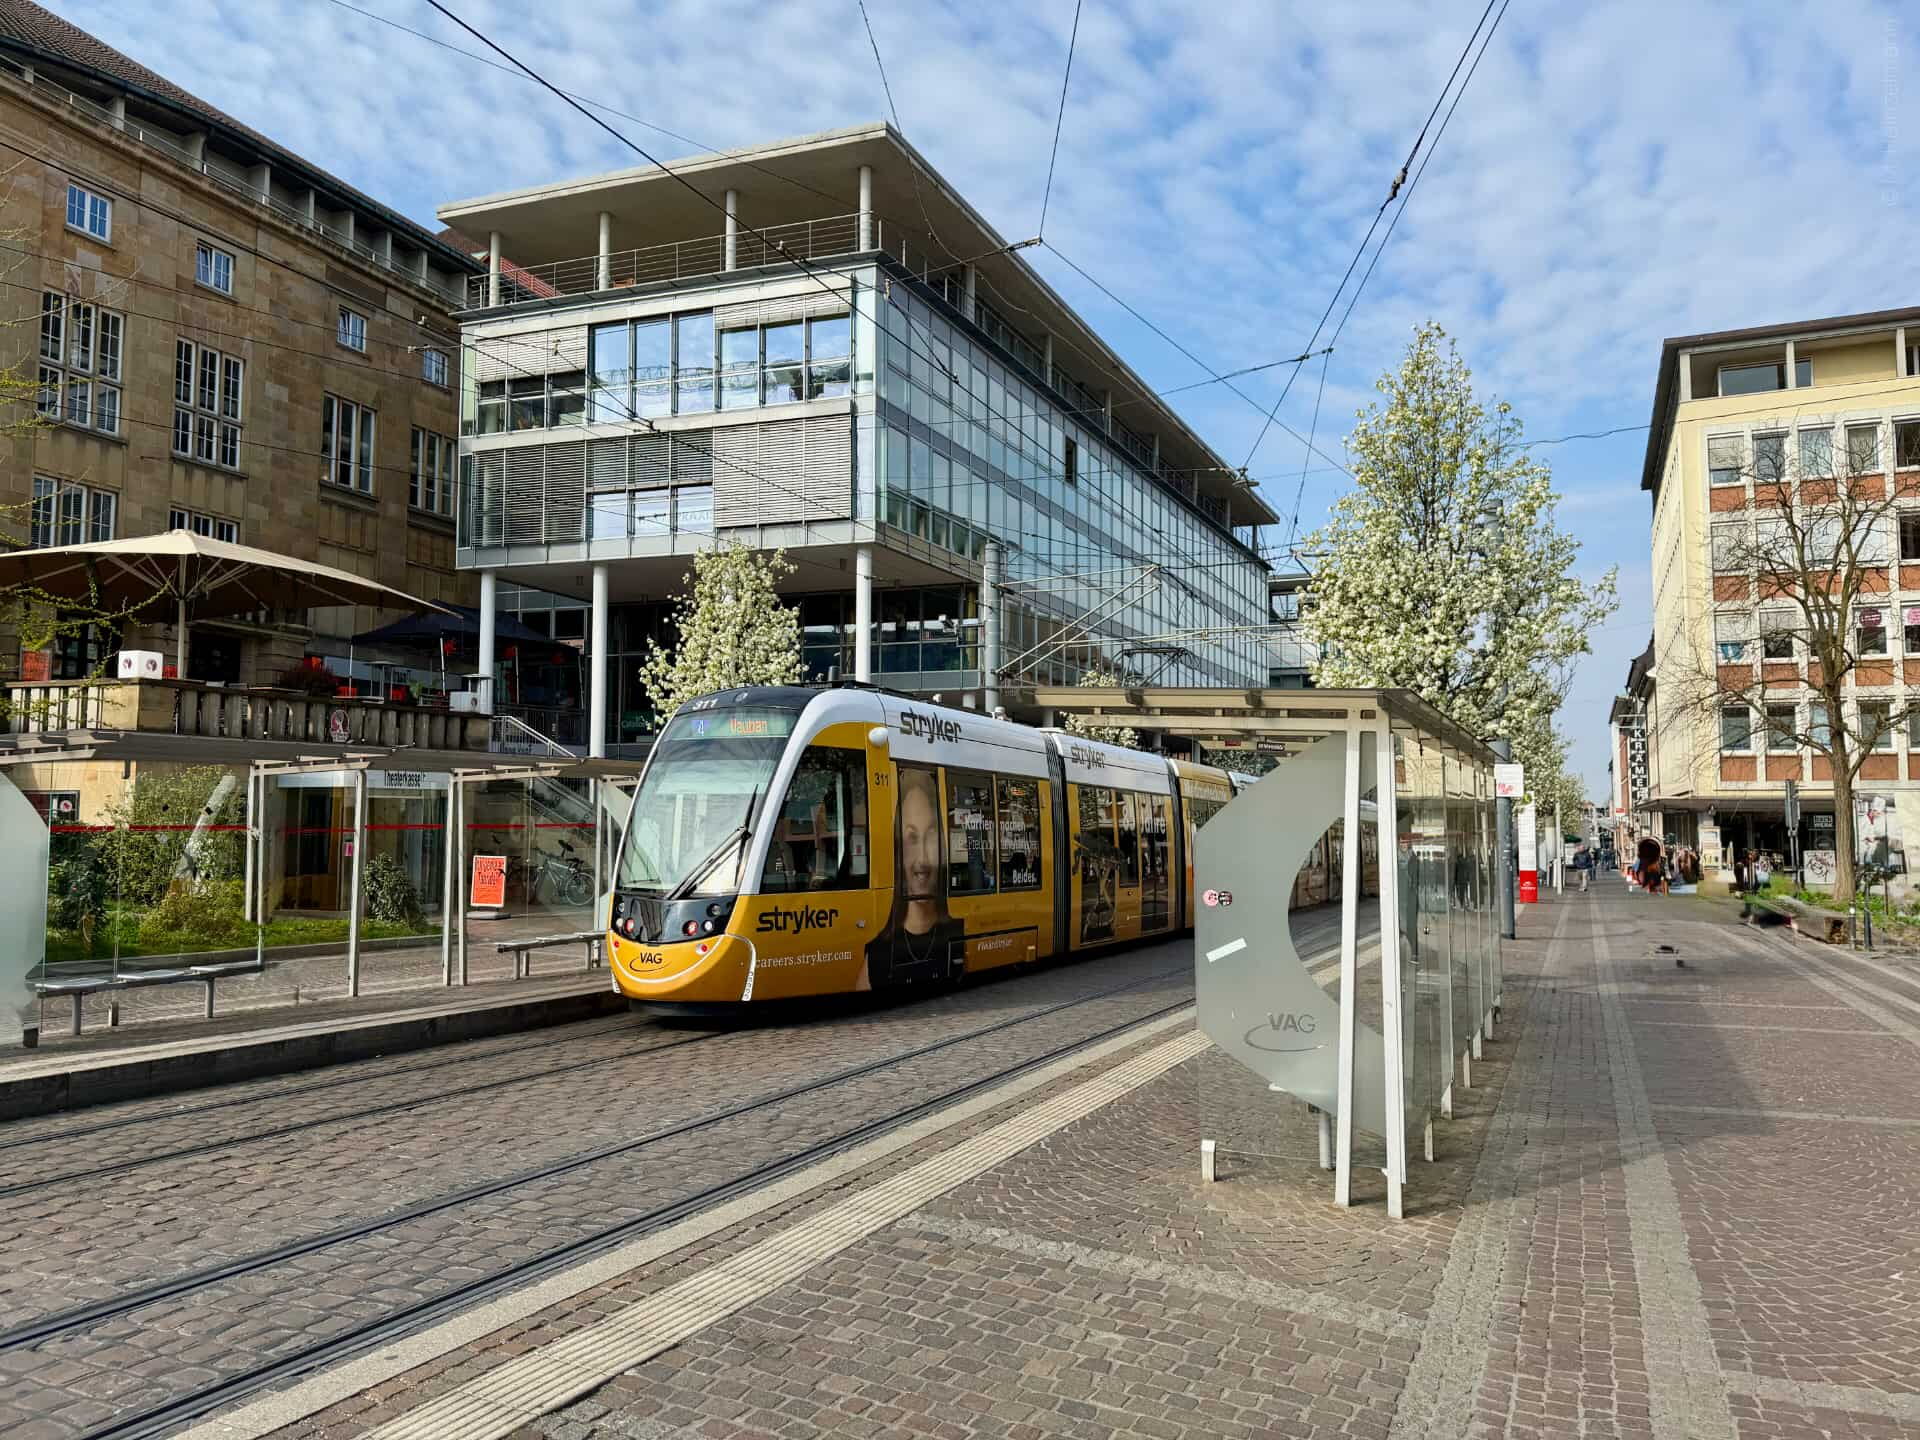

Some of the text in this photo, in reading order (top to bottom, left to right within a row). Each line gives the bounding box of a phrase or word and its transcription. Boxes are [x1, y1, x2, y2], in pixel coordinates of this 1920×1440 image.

[692, 698, 719, 711] 311
[730, 717, 769, 735] Vauban
[900, 706, 962, 744] stryker
[1071, 743, 1105, 770] stryker
[874, 772, 889, 787] 311
[756, 905, 839, 934] stryker
[640, 952, 663, 965] VAG
[755, 950, 852, 969] careers.stryker.com
[1267, 1013, 1316, 1034] VAG
